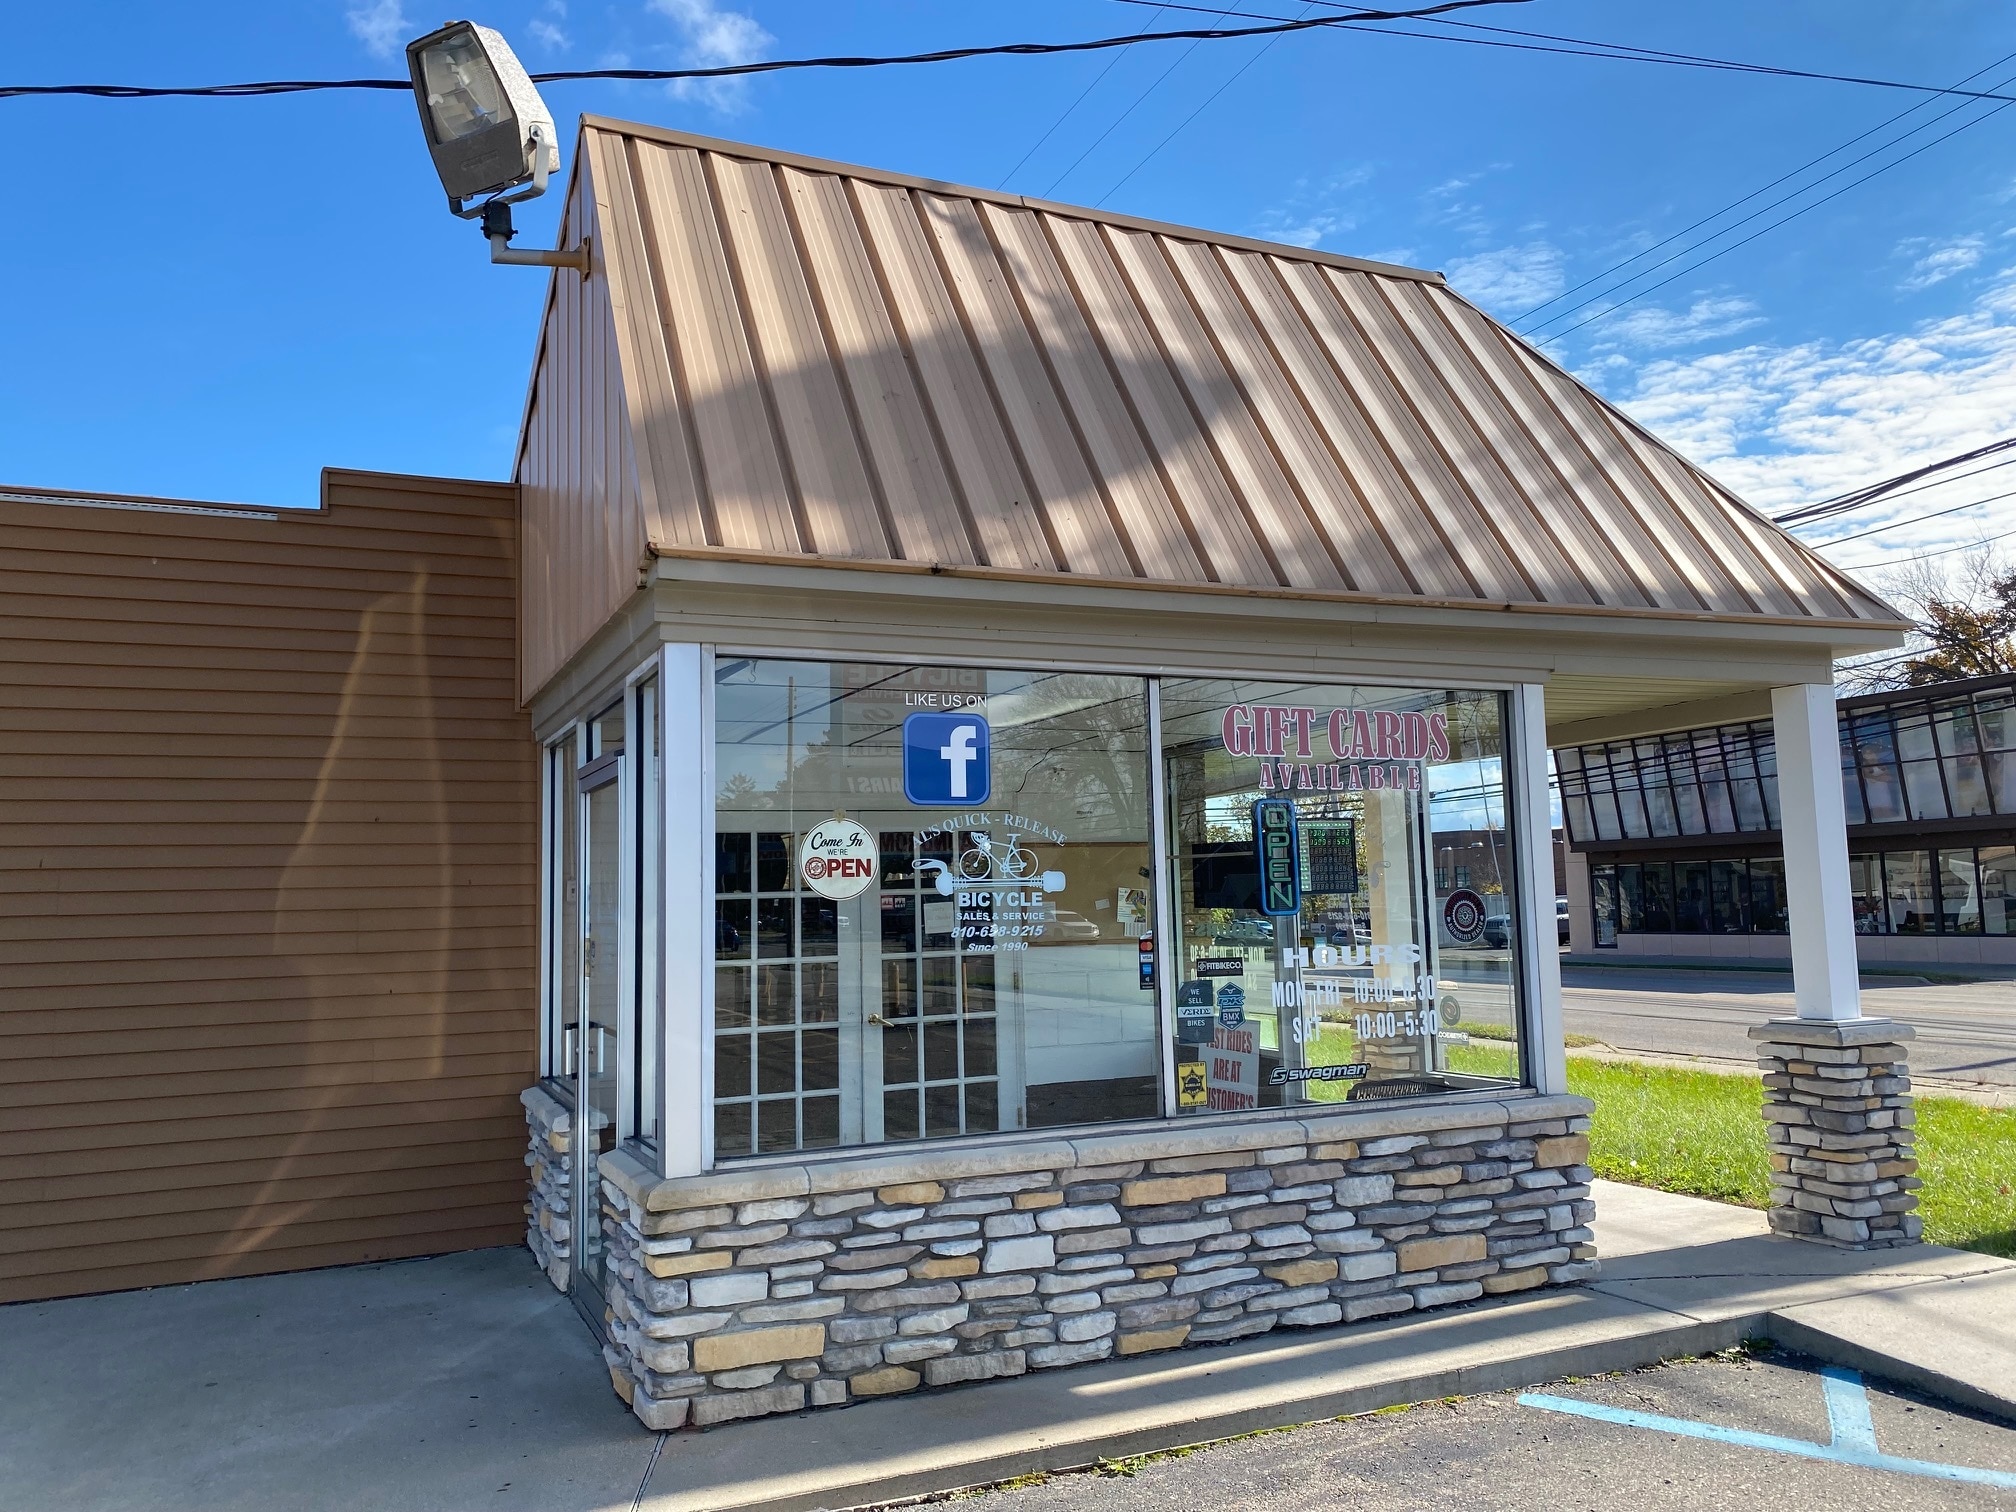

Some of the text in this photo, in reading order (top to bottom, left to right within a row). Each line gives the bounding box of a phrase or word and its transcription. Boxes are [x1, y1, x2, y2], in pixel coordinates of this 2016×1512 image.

[905, 693, 938, 707] LIKE
[942, 694, 962, 708] US
[966, 695, 987, 708] ON
[1222, 704, 1451, 762] GIFT CARDS
[940, 725, 977, 798] f
[1259, 762, 1421, 792] AVAILABLE
[811, 832, 843, 850] Come
[846, 832, 864, 847] In
[912, 824, 941, 849] AL'S
[942, 812, 991, 832] QUICK
[1004, 813, 1068, 847] RELEASE
[805, 857, 871, 879] OPEN
[1265, 807, 1293, 909] OPEN
[958, 892, 1043, 907] BICYCLE
[956, 912, 1045, 921] SALES & SERVICE
[967, 942, 1028, 952] Since 1990
[1283, 943, 1421, 968] HOURS
[1353, 974, 1436, 1004] 10:00-6:30
[1292, 1010, 1438, 1044] SAT 10:00-5:30
[1227, 1030, 1252, 1055] RIDES
[1213, 1057, 1229, 1080] ARE
[1231, 1061, 1242, 1083] AT
[1289, 1064, 1367, 1080] swagman
[1207, 1086, 1253, 1111] USTOMER'S
